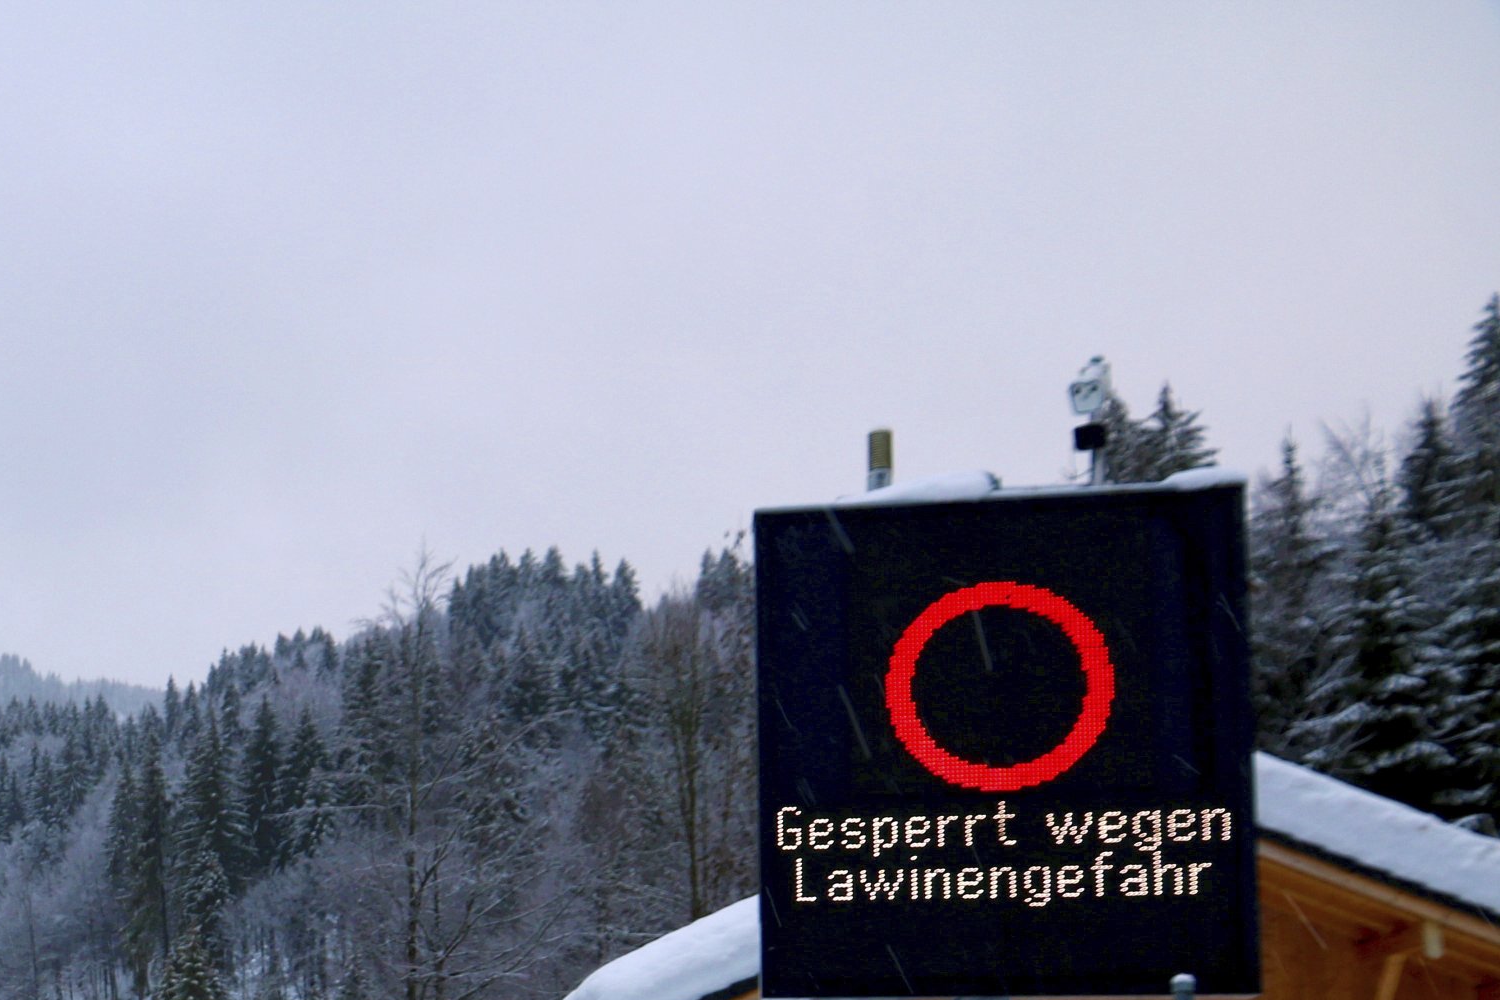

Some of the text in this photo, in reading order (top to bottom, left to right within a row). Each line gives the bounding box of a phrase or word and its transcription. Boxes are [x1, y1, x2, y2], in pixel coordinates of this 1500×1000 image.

[775, 799, 1233, 859] Gesperrt wegen
[794, 850, 1214, 908] Lawinengefahr
